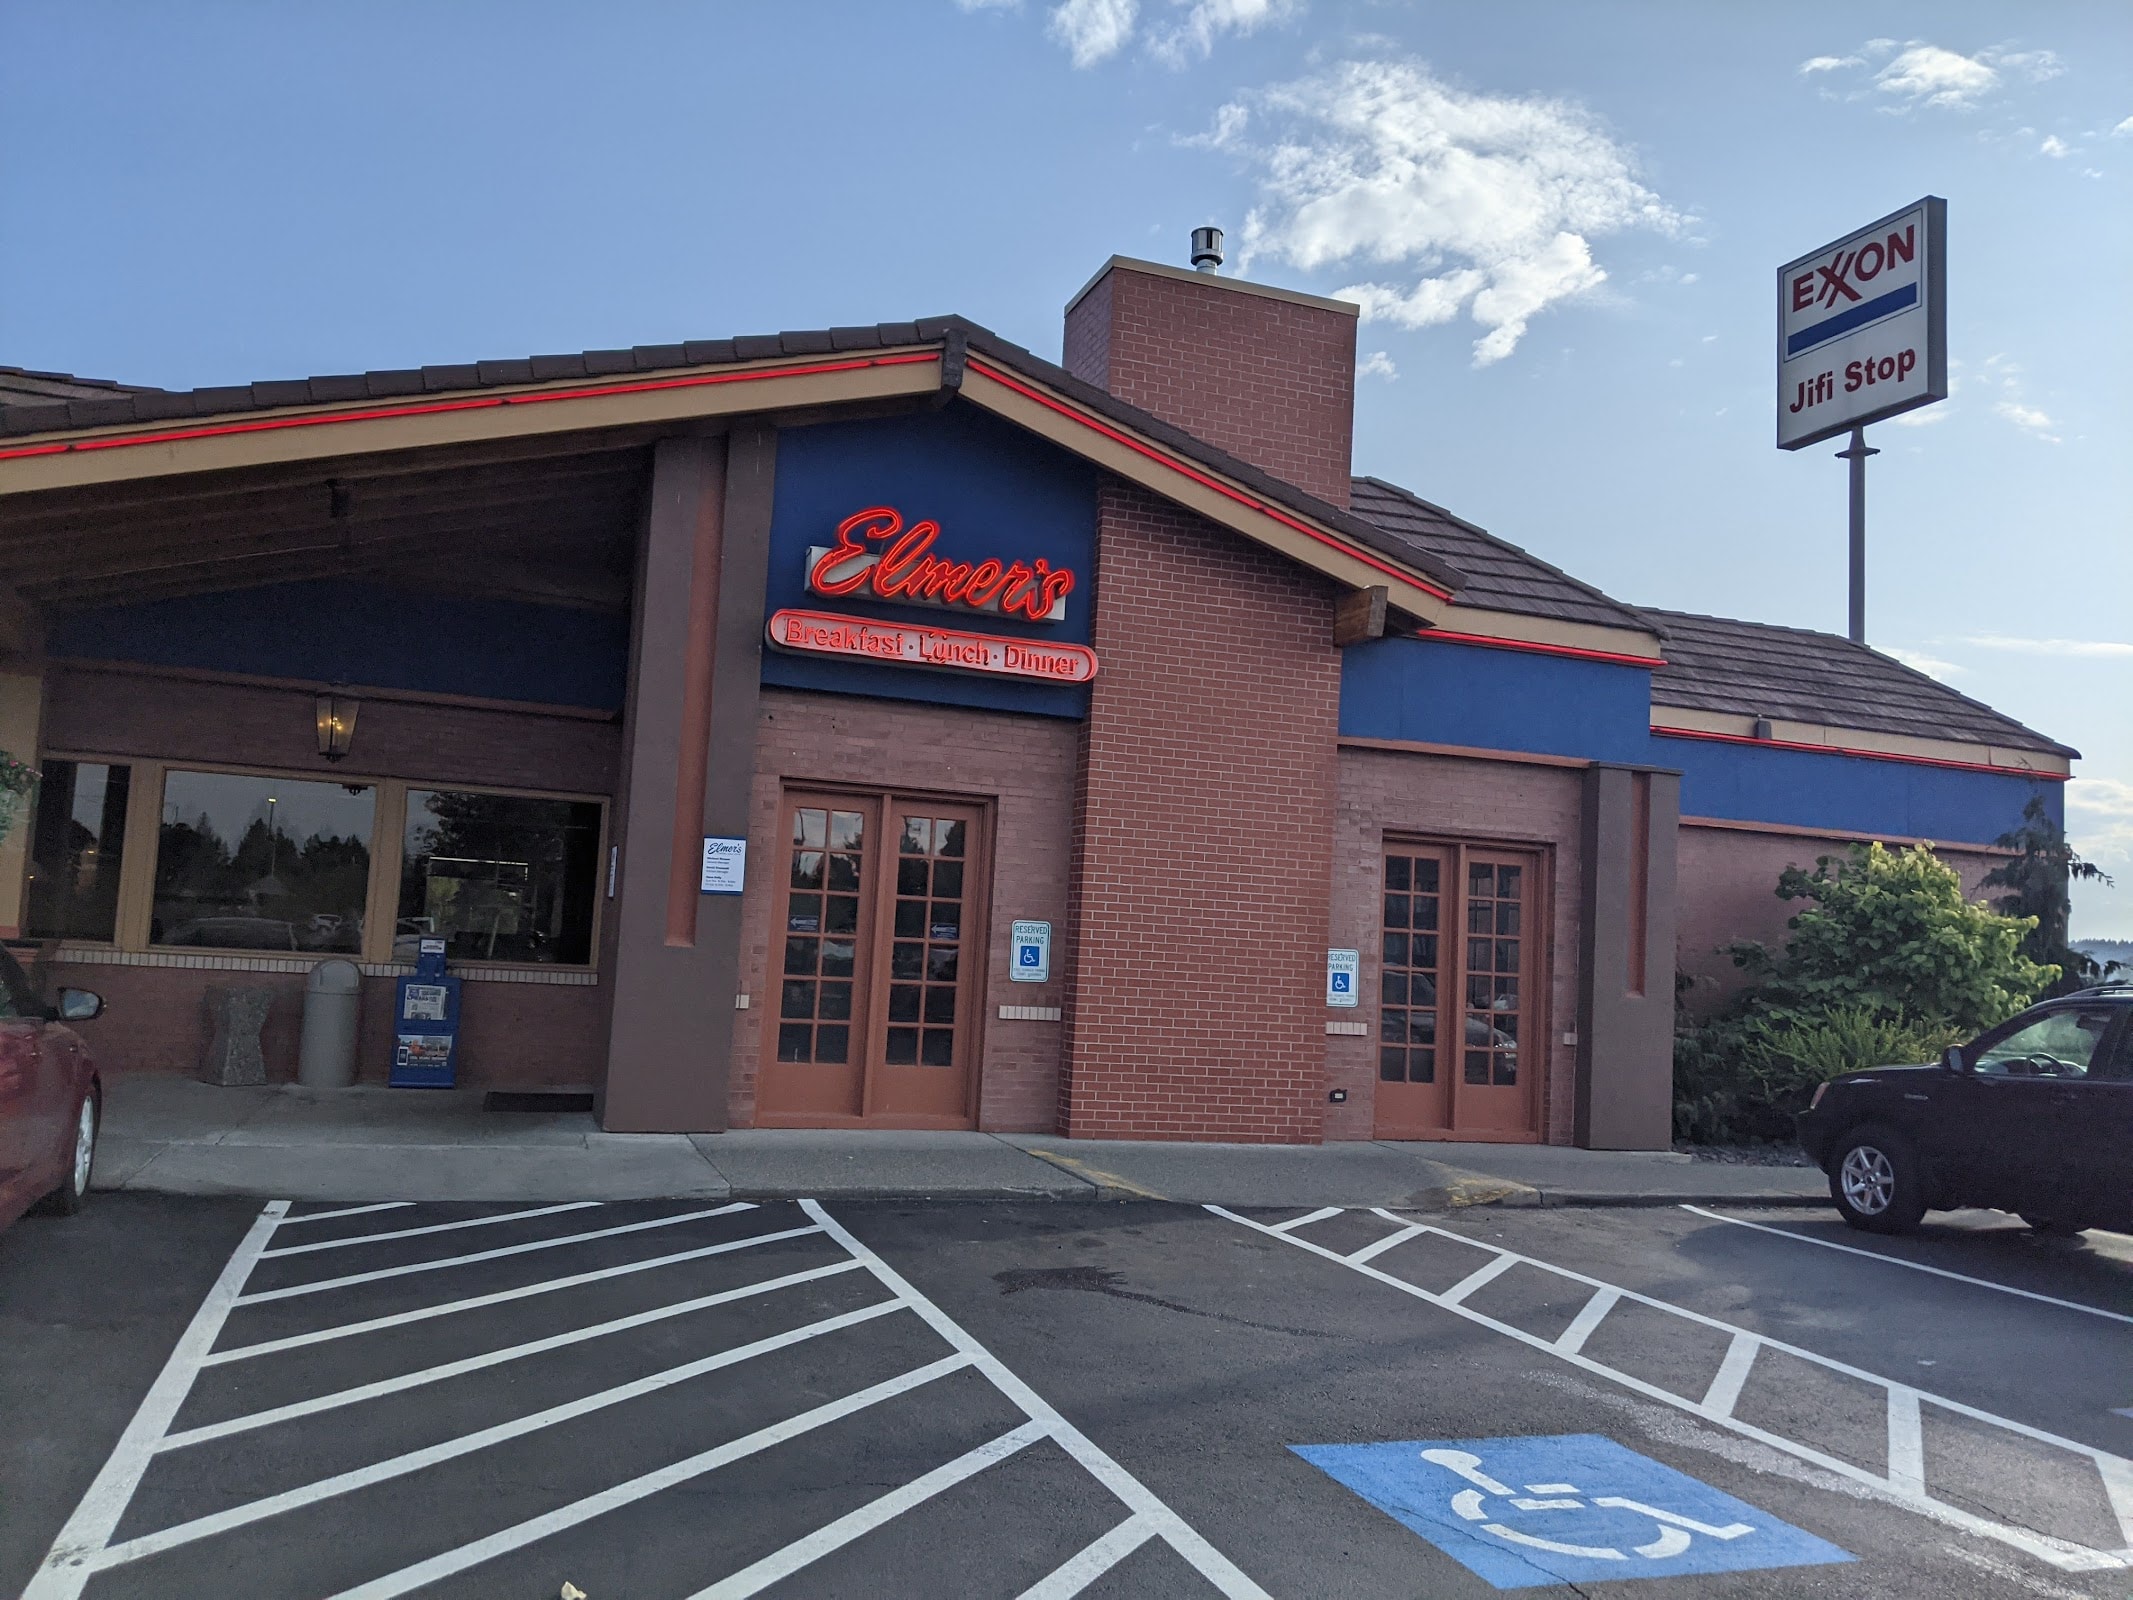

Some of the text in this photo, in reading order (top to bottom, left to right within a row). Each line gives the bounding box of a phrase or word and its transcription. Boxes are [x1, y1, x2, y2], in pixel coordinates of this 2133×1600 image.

[1792, 224, 1915, 313] EXXON
[1789, 347, 1916, 414] Jifi Stop
[810, 505, 1076, 621] Elmer's
[784, 617, 1080, 675] Breakfast Lunch Dinner
[707, 842, 742, 855] Elmer's
[1015, 925, 1048, 934] RESERVED
[1016, 936, 1045, 944] PARKING
[1328, 963, 1353, 971] PARKING
